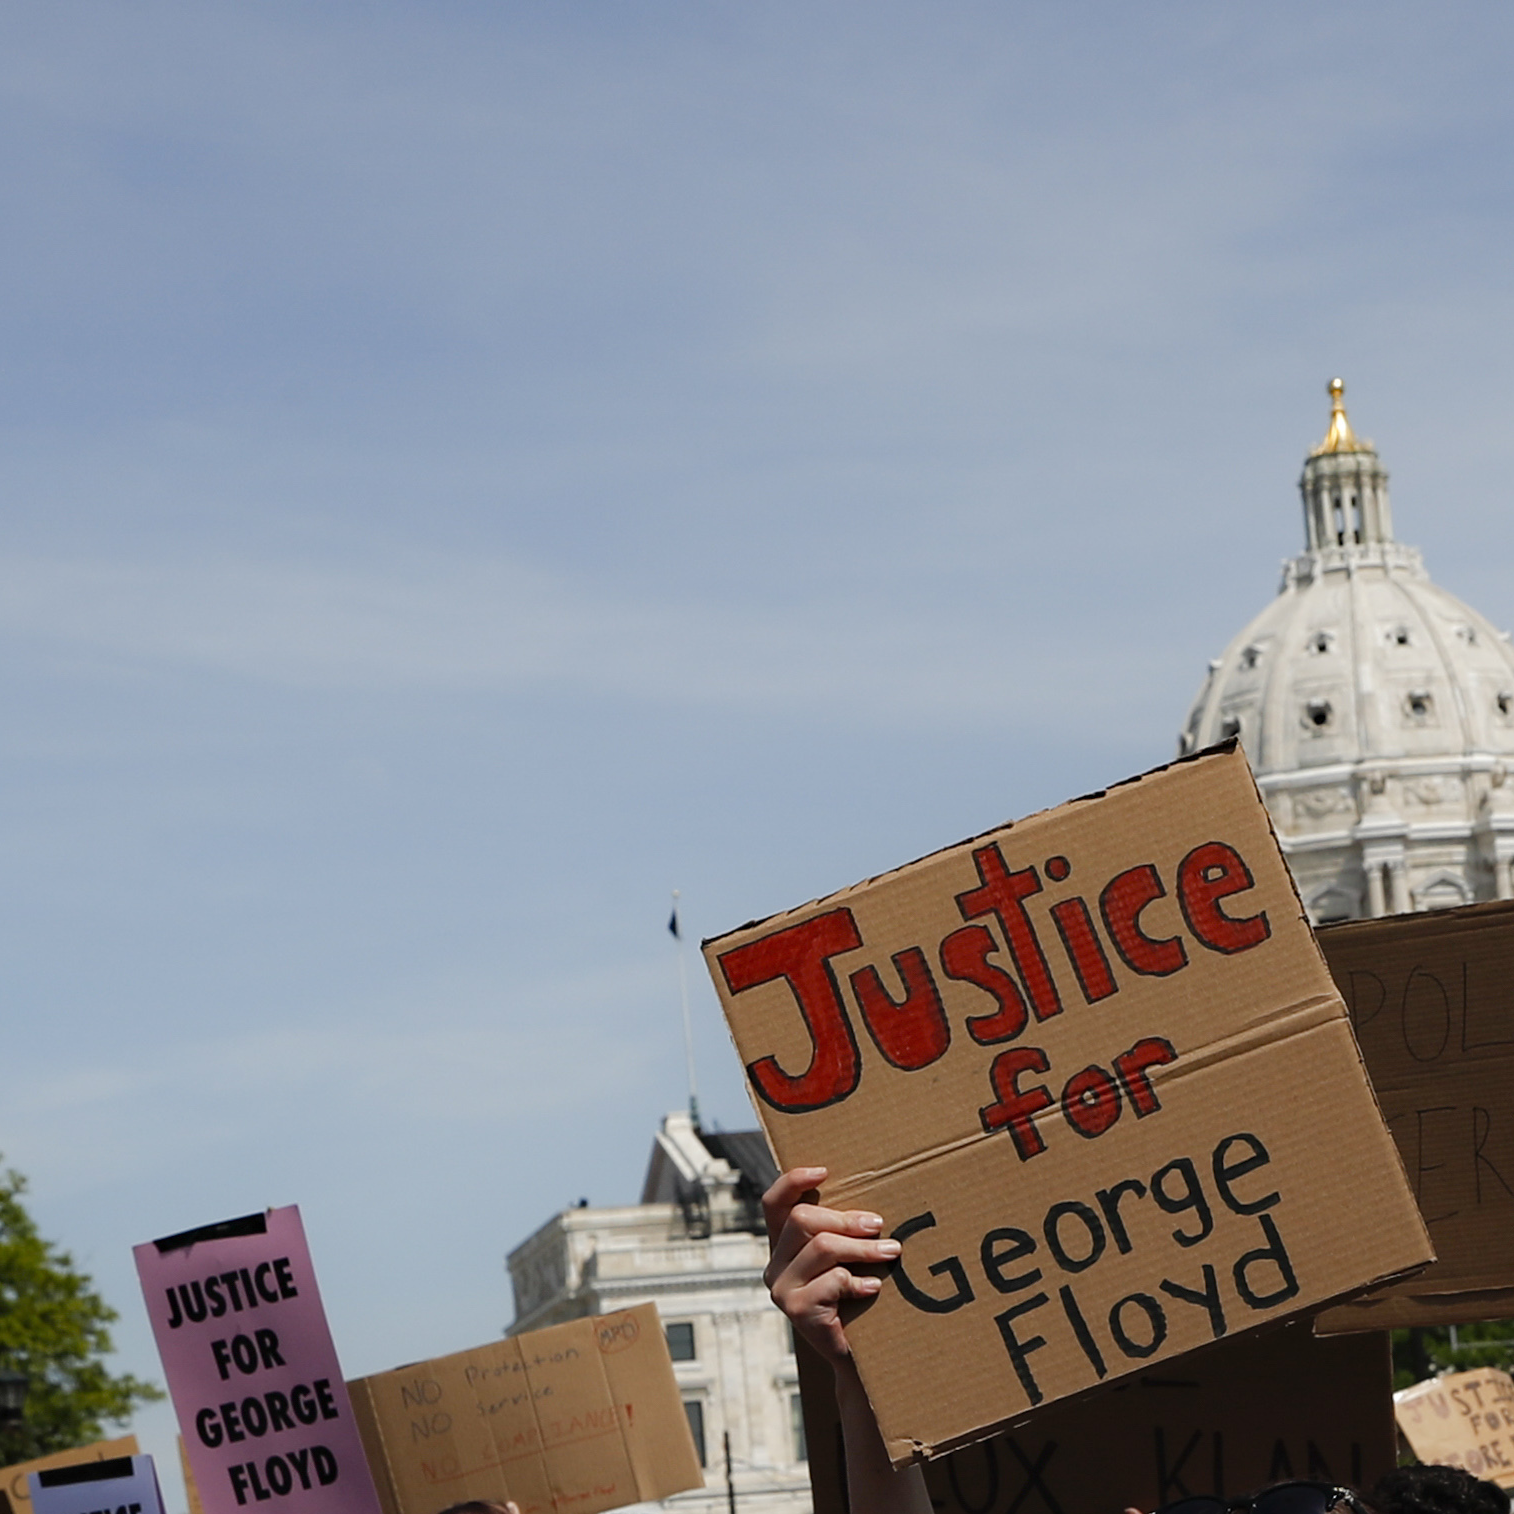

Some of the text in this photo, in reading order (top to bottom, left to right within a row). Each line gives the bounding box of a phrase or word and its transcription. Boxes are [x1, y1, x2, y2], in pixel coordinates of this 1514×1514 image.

[717, 841, 1271, 1114] Justice
[979, 1036, 1178, 1162] for
[888, 1133, 1282, 1315] George
[165, 1257, 298, 1329] JUSTICE
[994, 1213, 1300, 1405] Floyd
[211, 1328, 286, 1381] FOR
[196, 1378, 339, 1448] GEORGE
[401, 1379, 442, 1409] NO
[411, 1412, 452, 1443] NO
[228, 1445, 339, 1505] FLOYD
